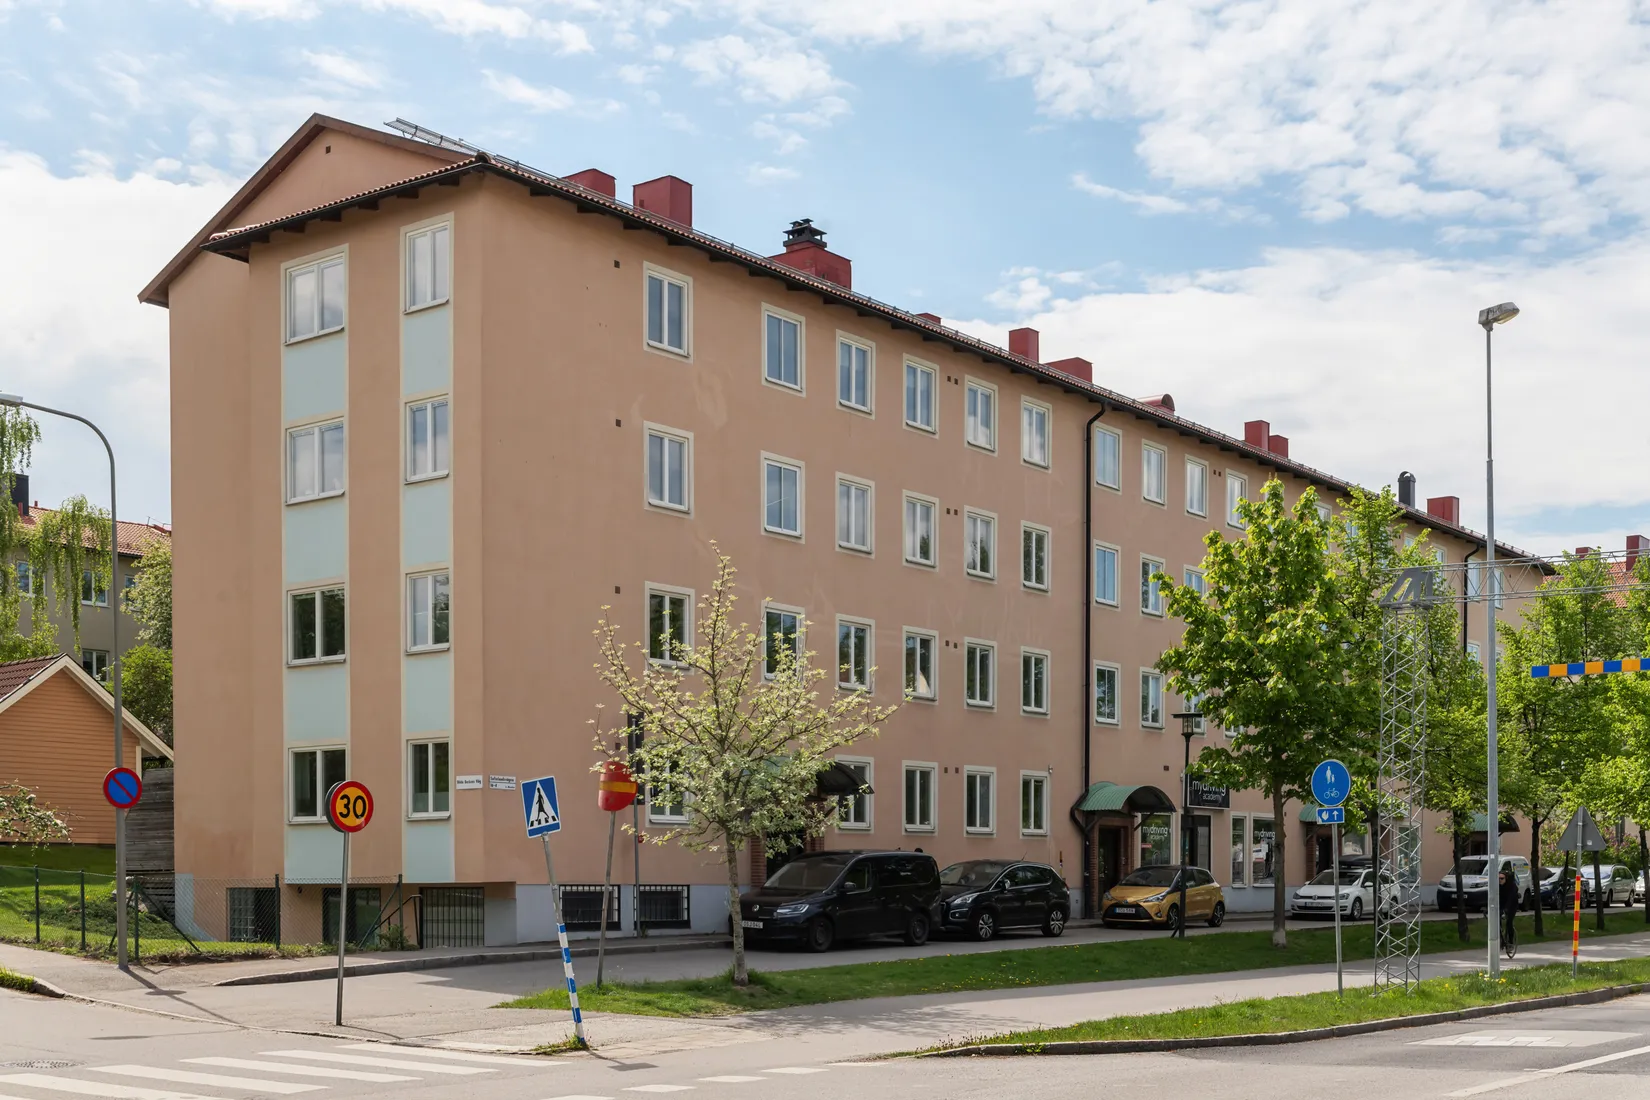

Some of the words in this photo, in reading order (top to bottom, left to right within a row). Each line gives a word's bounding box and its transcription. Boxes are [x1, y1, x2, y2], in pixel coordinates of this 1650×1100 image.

[1202, 793, 1222, 803] academy
[339, 794, 367, 819] 30
[1142, 824, 1168, 837] mydriving
